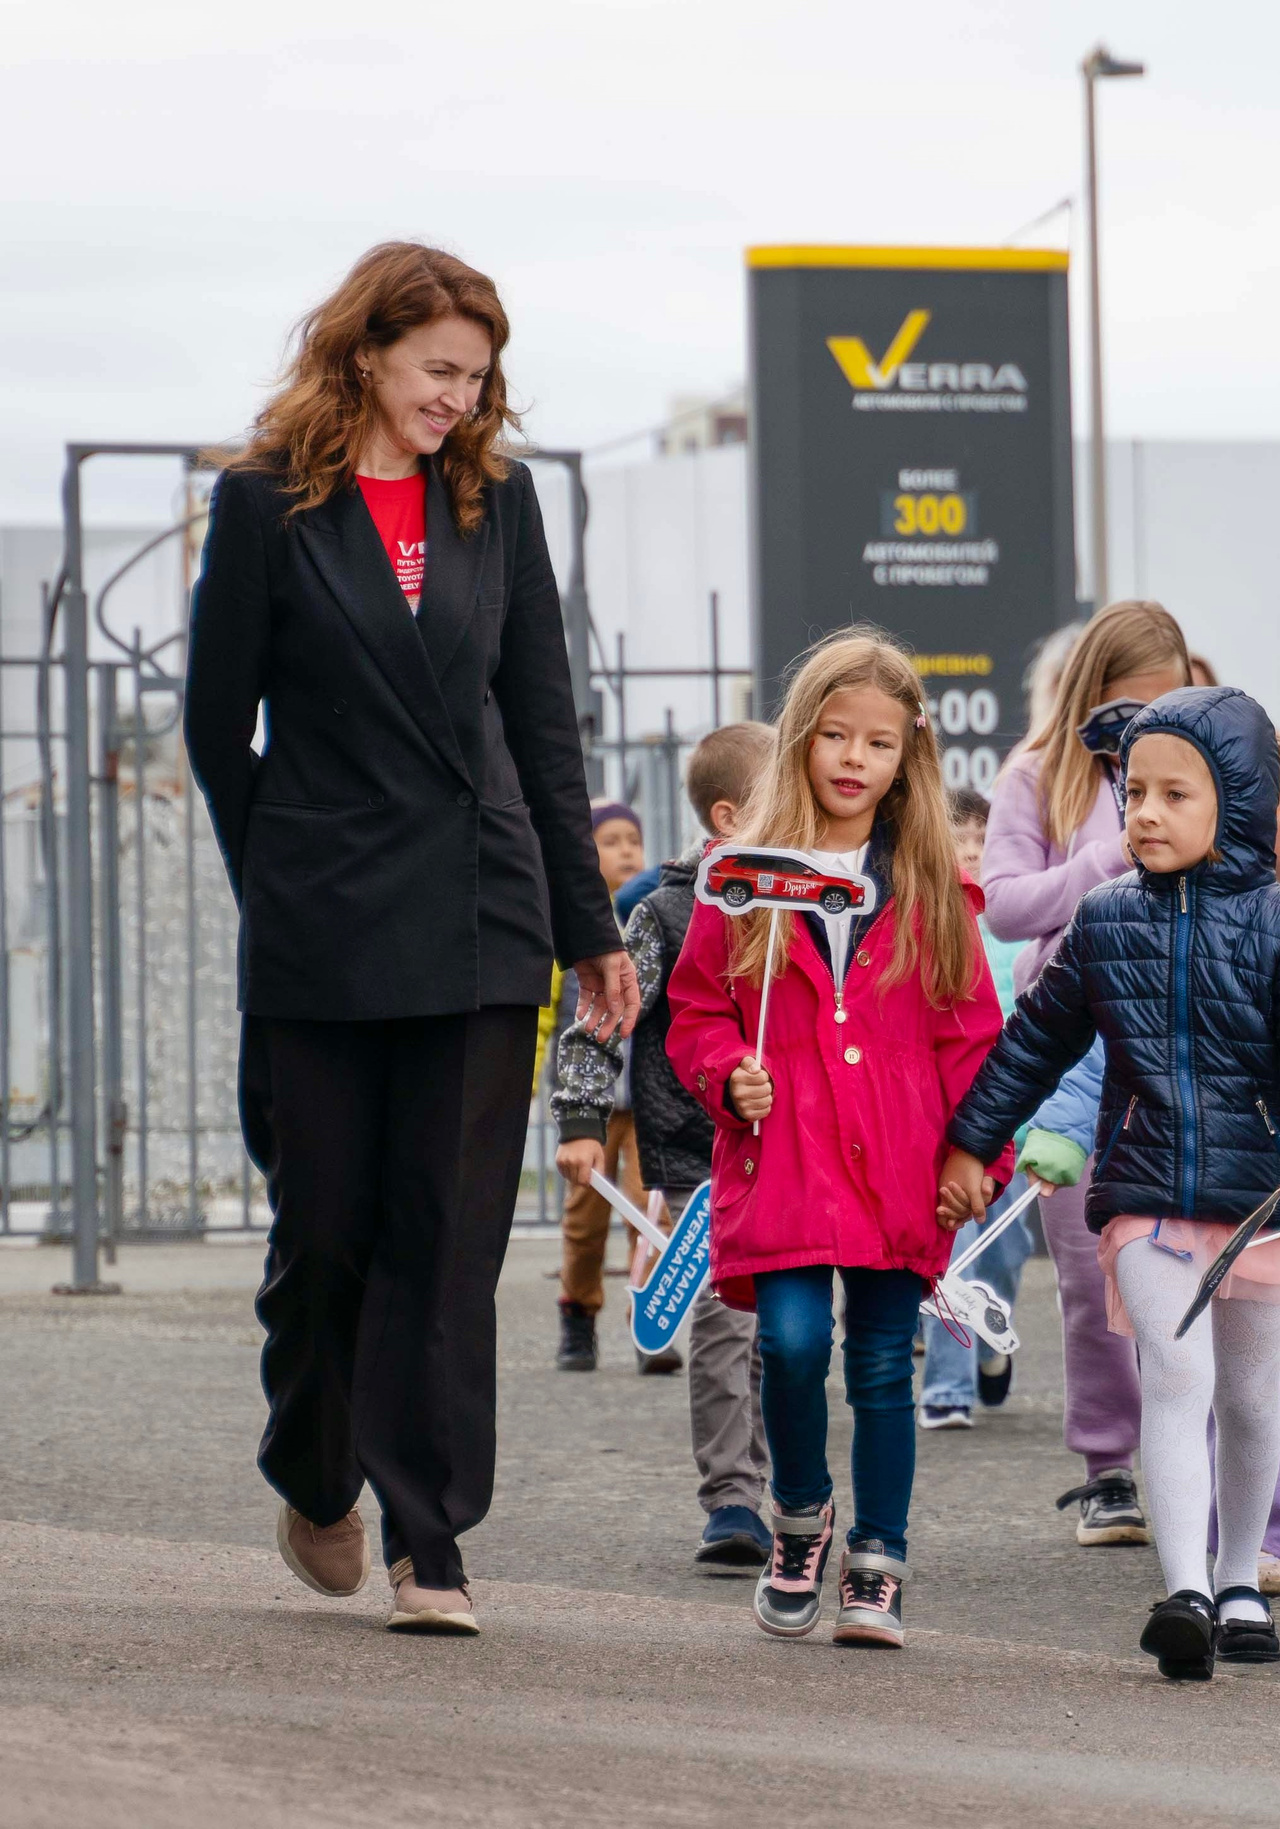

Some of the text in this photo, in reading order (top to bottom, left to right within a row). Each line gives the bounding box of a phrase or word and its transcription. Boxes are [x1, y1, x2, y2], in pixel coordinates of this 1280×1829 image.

[825, 307, 1029, 391] VERRA
[899, 468, 957, 490] БОЛЕЕ
[894, 494, 966, 535] 300
[862, 537, 998, 562] АВТОМОБИЛЕЙ
[889, 565, 989, 585] ПРОБЕГОМ
[665, 1264, 698, 1313] ПАПА
[657, 1318, 671, 1331] В
